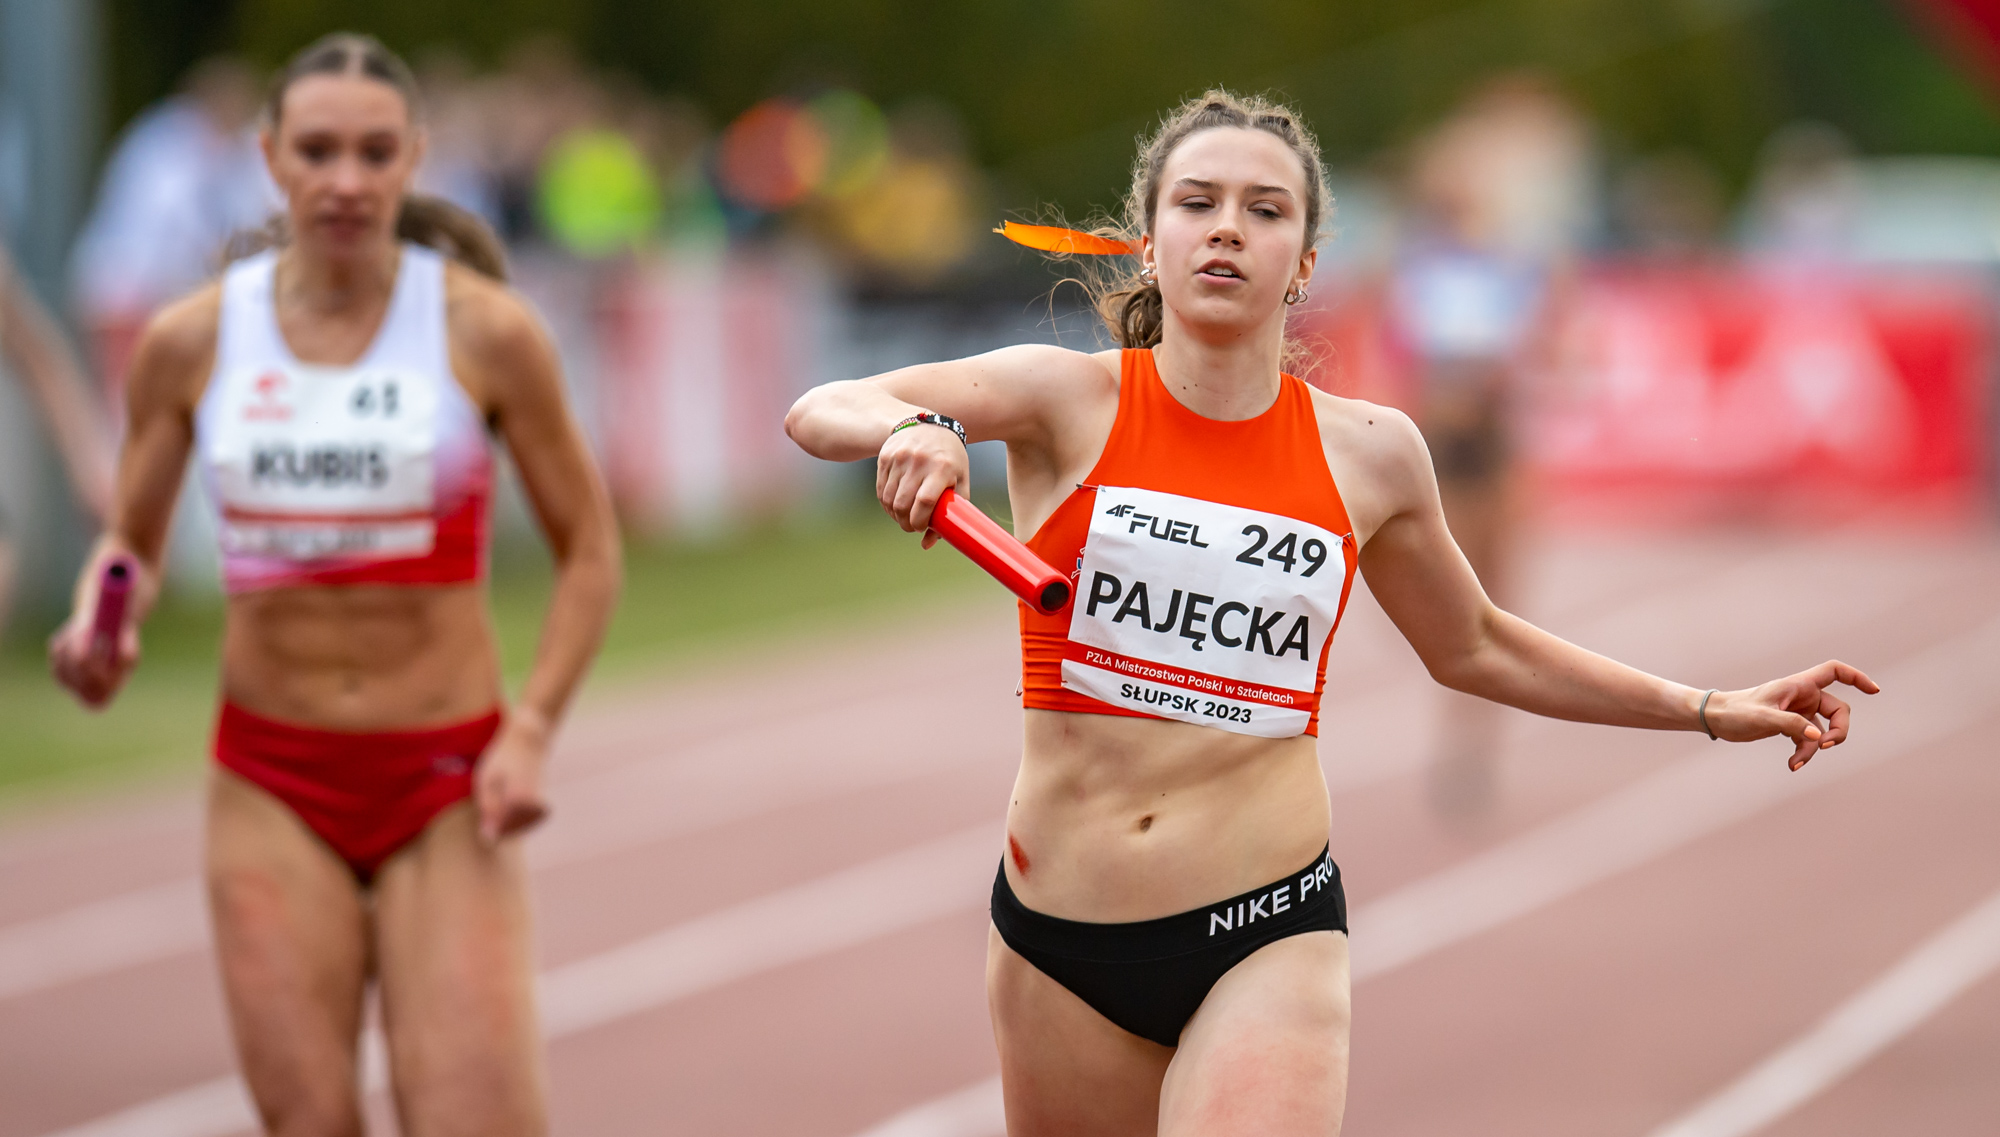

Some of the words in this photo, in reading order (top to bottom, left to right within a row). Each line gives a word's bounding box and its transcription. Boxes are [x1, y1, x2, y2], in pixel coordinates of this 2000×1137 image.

[249, 443, 389, 490] KUBIS
[1128, 512, 1210, 549] FUEL
[1235, 524, 1328, 578] 249
[1085, 570, 1311, 662] PAJĘCKA
[1085, 650, 1113, 668] PZLA
[1114, 653, 1186, 684] Mistrzostwa
[1187, 670, 1223, 693] Polski
[1224, 682, 1236, 694] w
[1236, 683, 1295, 705] Sztafetach
[1120, 682, 1200, 714] SŁUPSK
[1202, 700, 1253, 725] 2023
[1209, 884, 1291, 937] NIKE
[1300, 850, 1333, 903] PRO
